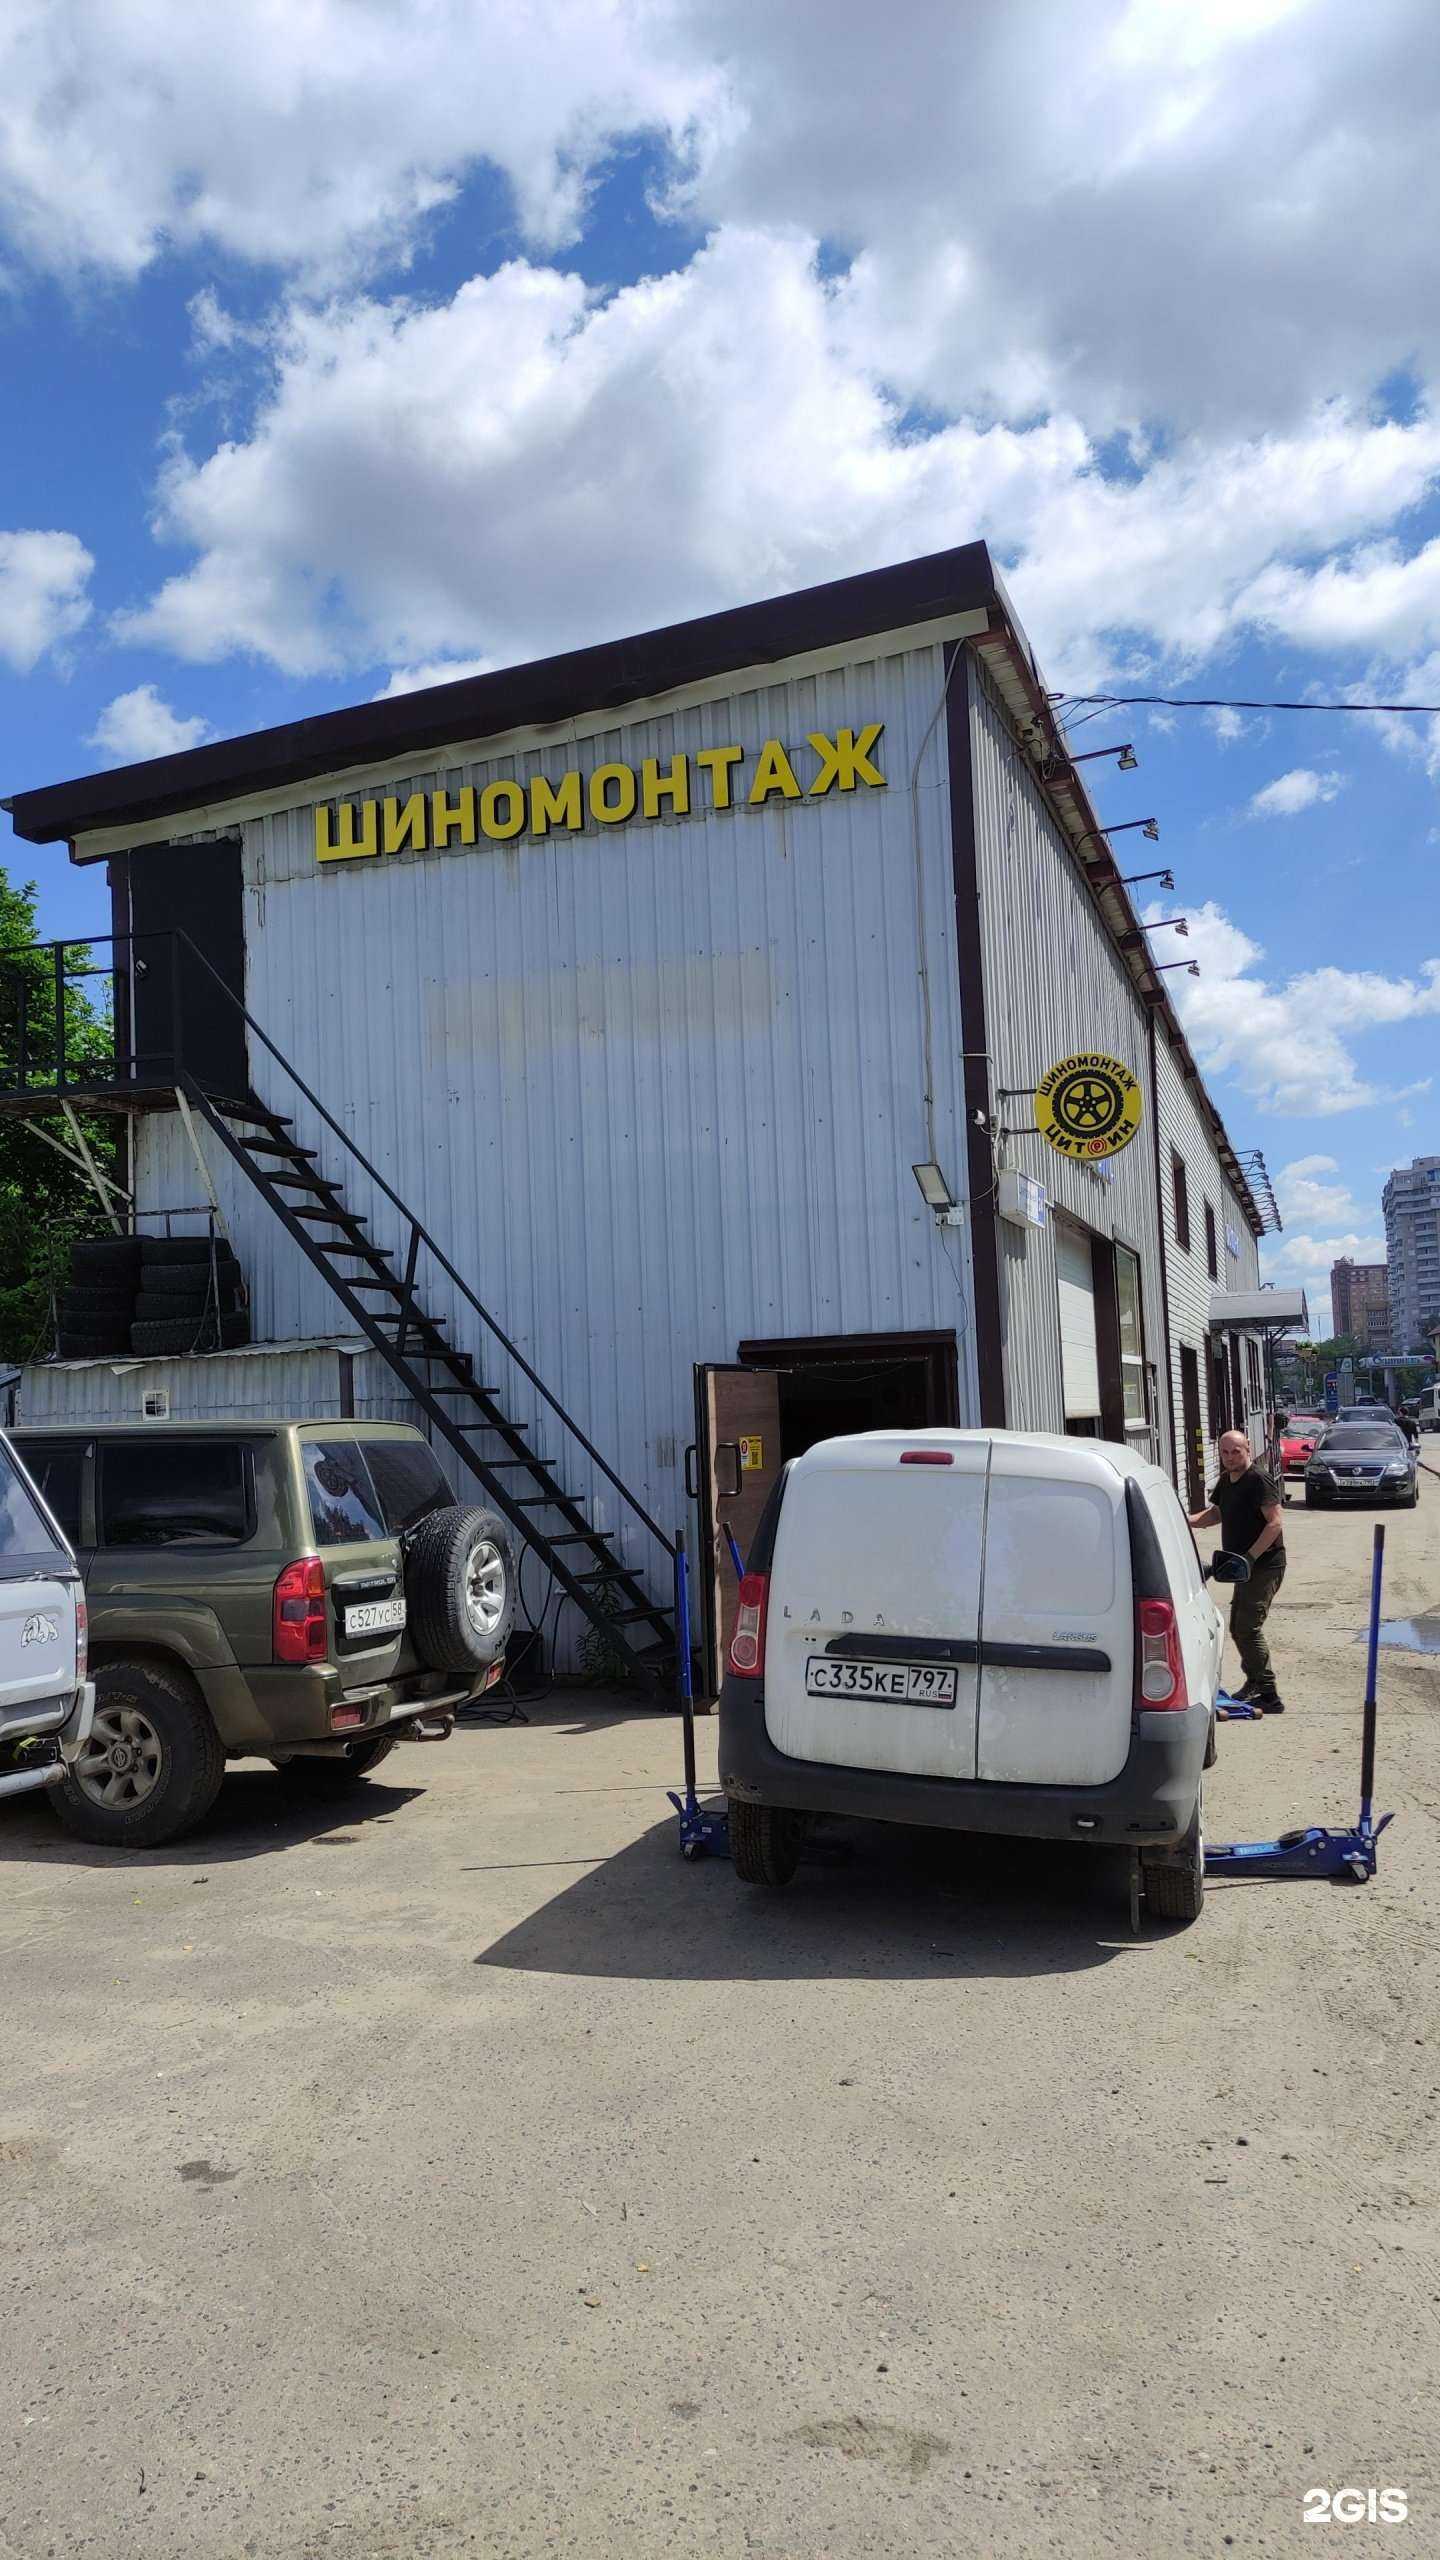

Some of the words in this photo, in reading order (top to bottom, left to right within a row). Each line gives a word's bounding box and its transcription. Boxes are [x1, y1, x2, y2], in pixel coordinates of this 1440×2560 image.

[315, 723, 888, 863] ШИНОМОНТАЖ
[1039, 1056, 1137, 1097] ШИНОМОНТАЖ
[783, 1605, 887, 1626] LADA
